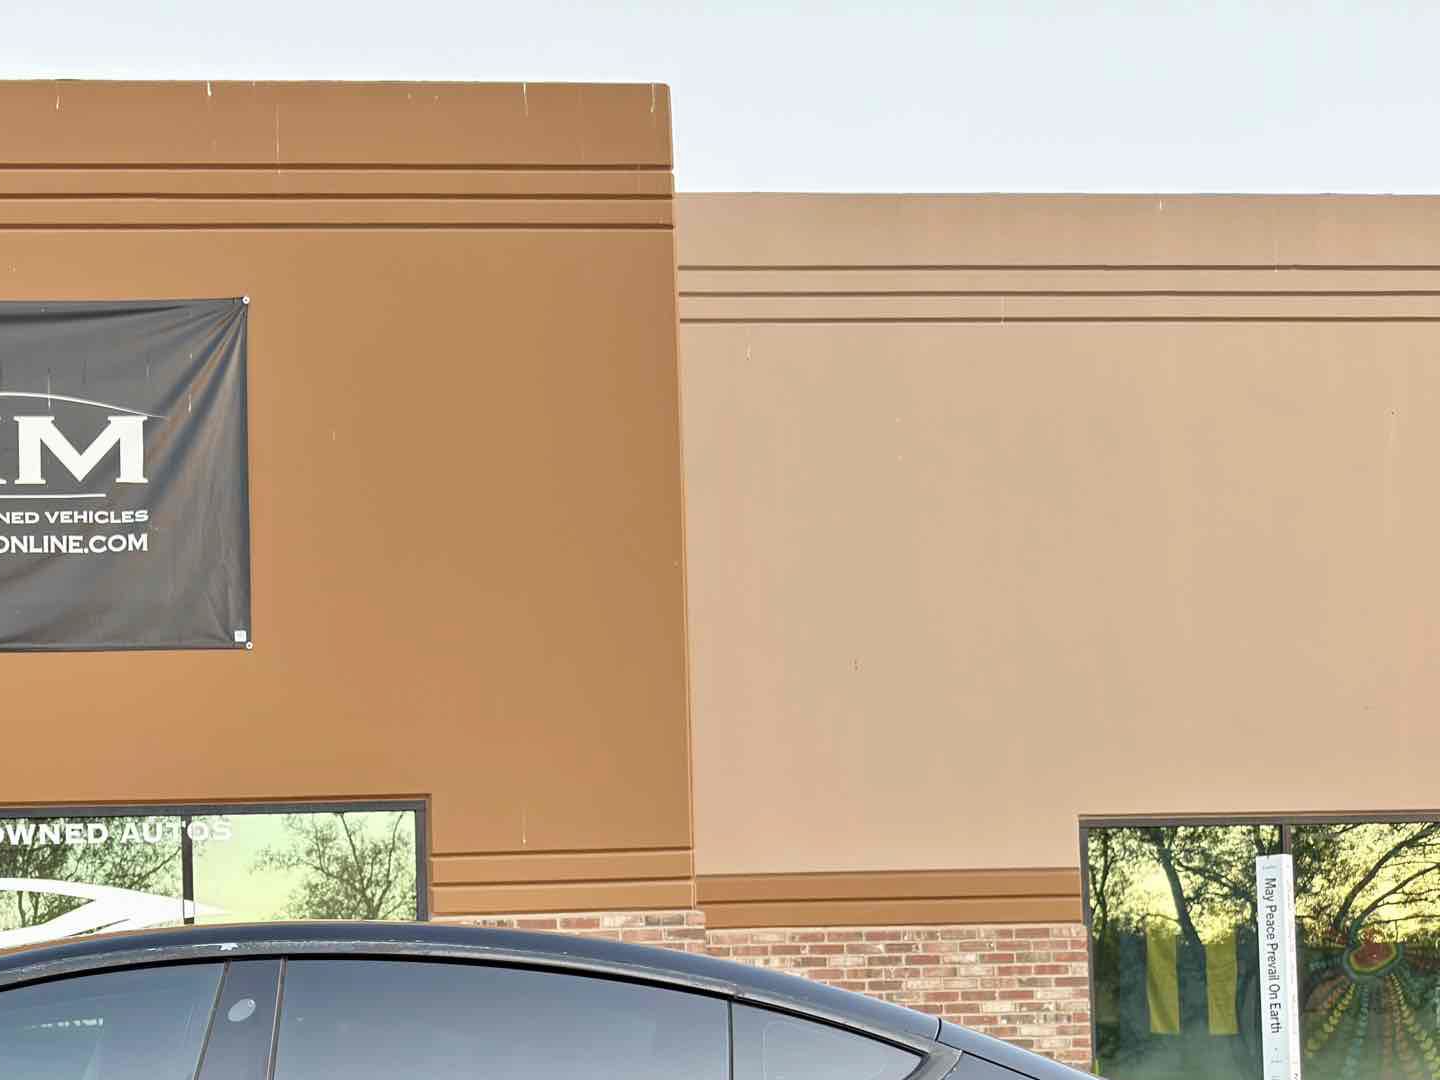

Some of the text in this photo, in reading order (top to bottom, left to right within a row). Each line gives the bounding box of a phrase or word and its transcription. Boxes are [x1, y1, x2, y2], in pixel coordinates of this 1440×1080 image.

[45, 510, 150, 524] VEHICLES
[120, 820, 233, 844] AUTOS
[1263, 878, 1283, 1034] May Peace Prevail On Earth
